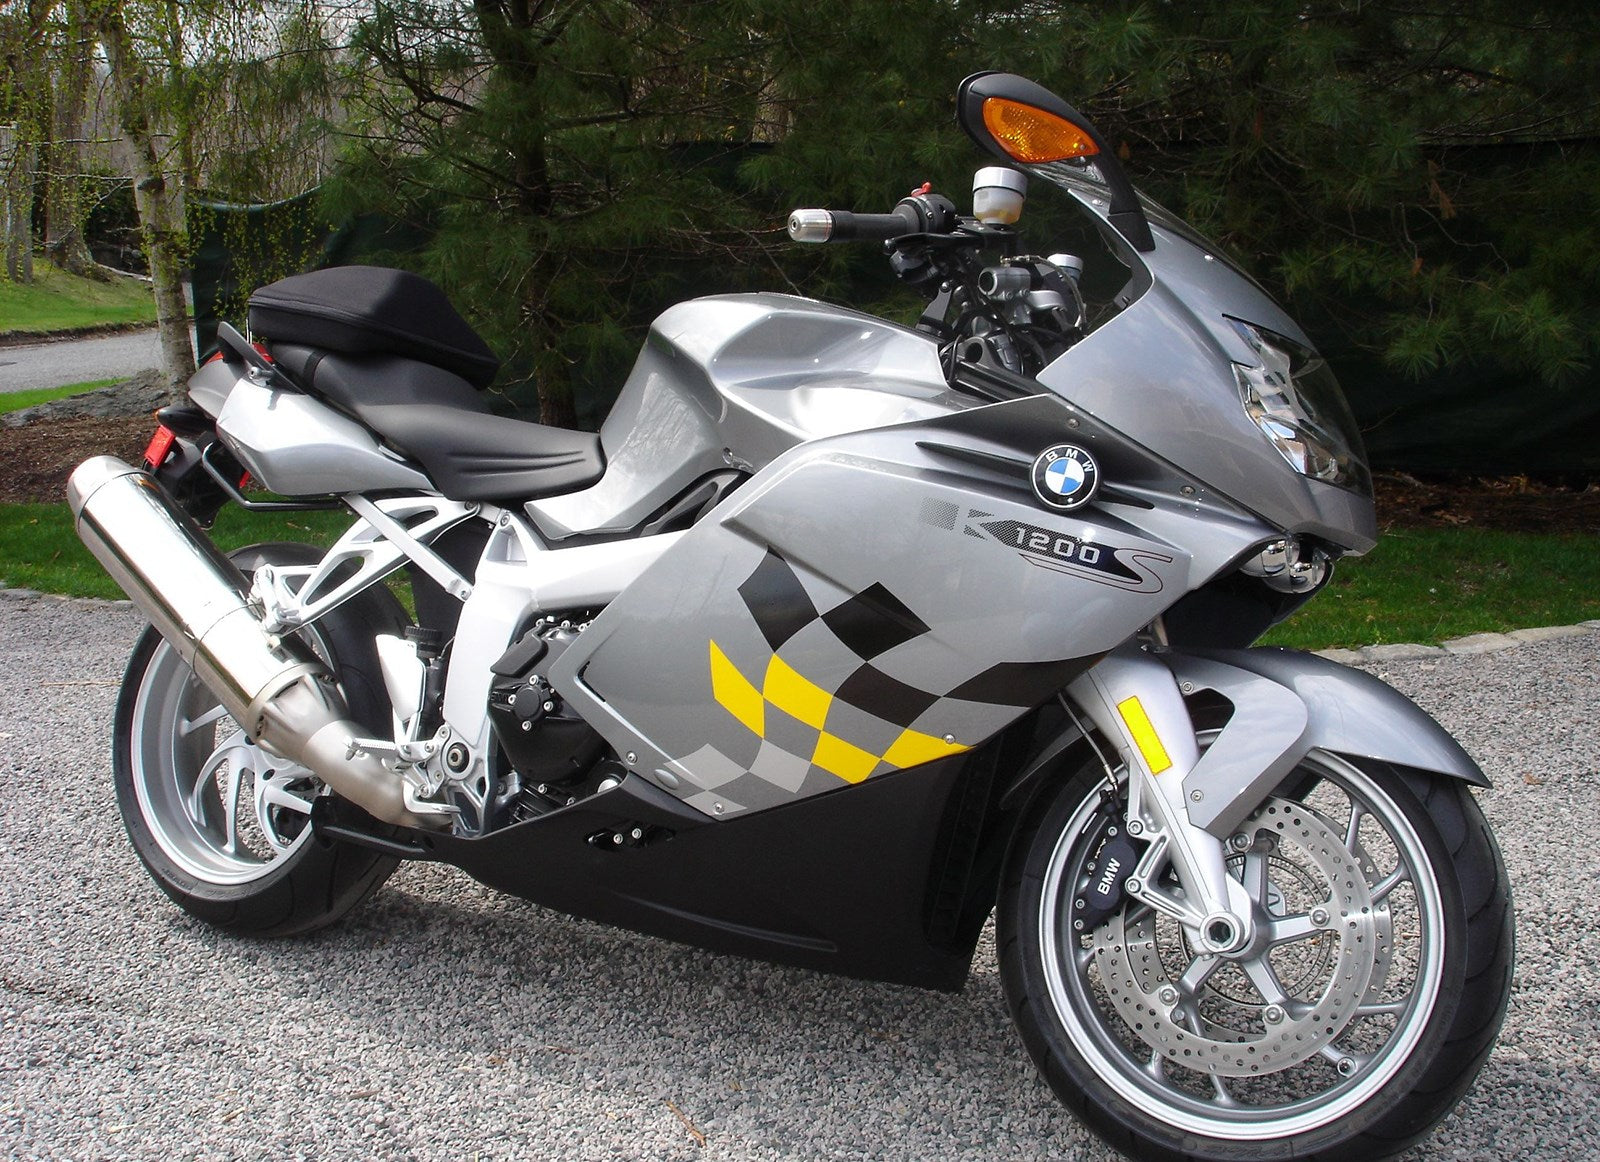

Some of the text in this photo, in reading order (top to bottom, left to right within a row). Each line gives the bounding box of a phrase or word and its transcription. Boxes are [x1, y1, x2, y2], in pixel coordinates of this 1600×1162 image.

[1045, 448, 1095, 473] BMW
[1015, 527, 1101, 565] 1200
[1097, 857, 1121, 895] BMW
